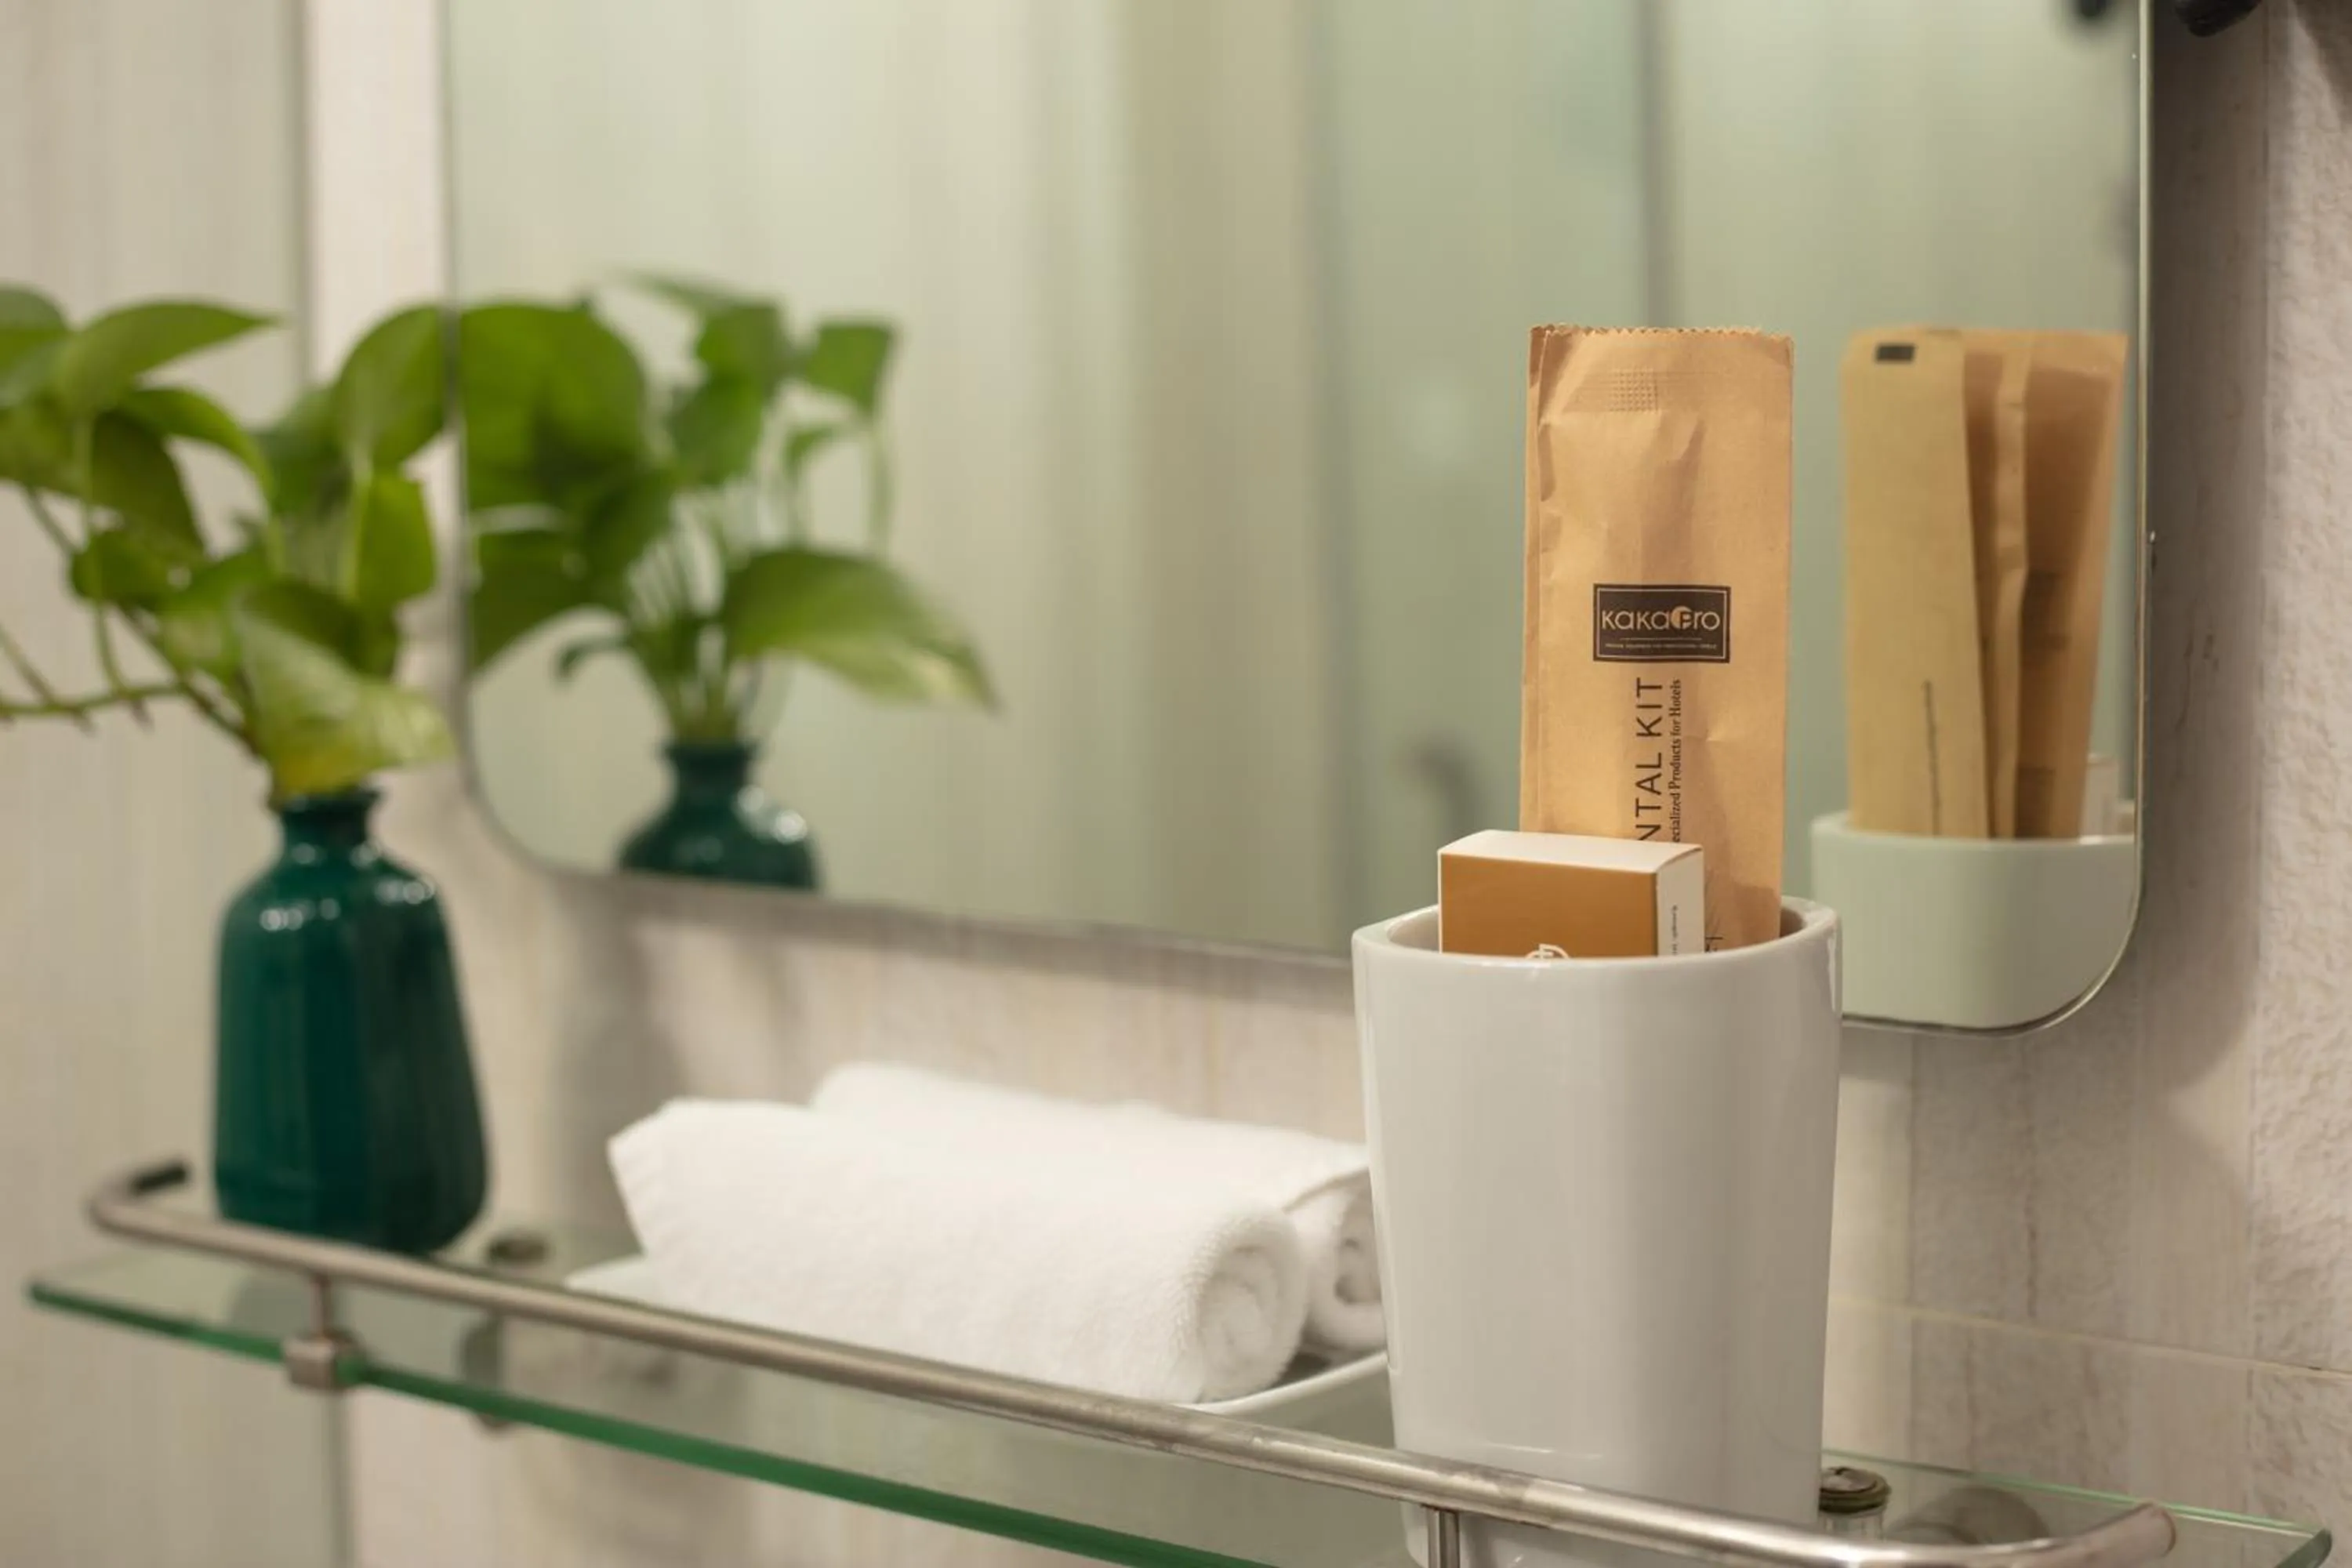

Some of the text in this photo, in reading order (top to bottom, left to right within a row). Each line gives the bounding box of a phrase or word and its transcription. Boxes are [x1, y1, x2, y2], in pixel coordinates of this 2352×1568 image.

[1635, 677, 1663, 841] NTAL KIT
[1668, 679, 1681, 843] ecialized Products for Hotels
